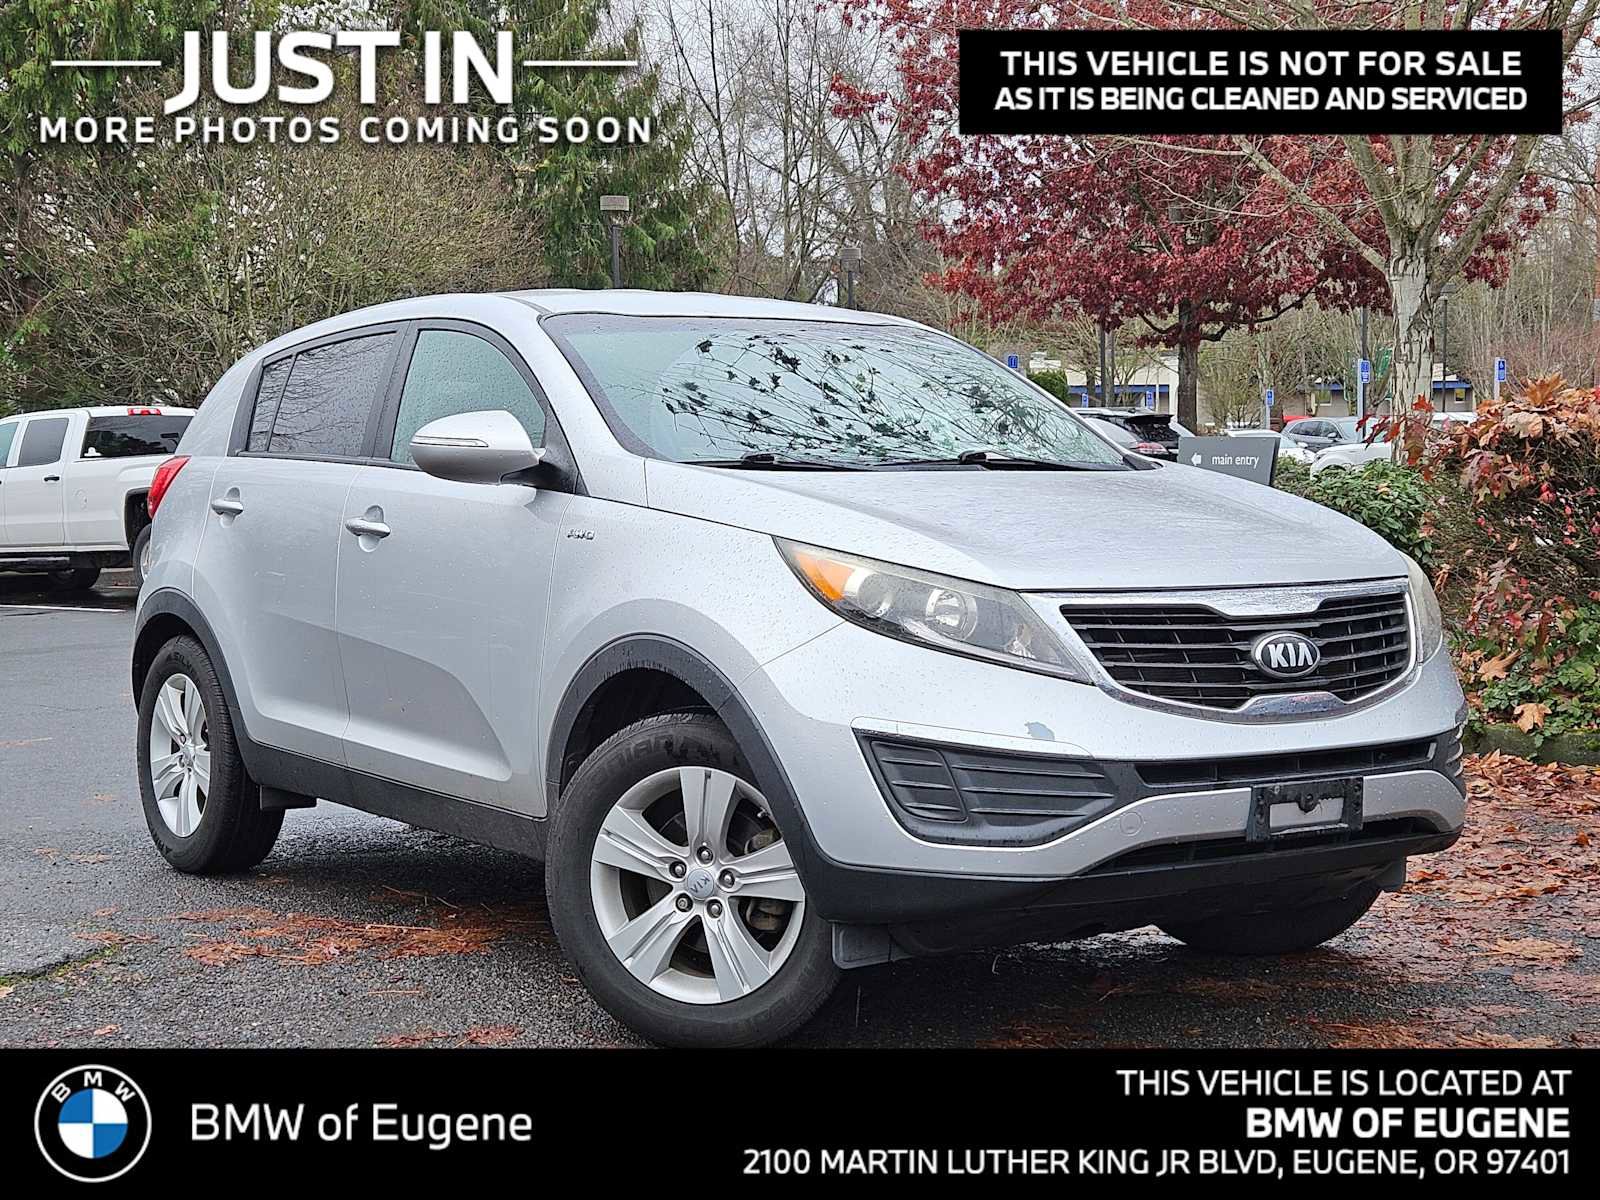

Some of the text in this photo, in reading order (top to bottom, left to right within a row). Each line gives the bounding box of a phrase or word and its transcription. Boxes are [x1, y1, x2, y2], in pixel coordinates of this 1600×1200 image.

[1211, 453, 1260, 470] main entry
[1267, 642, 1314, 668] KIA
